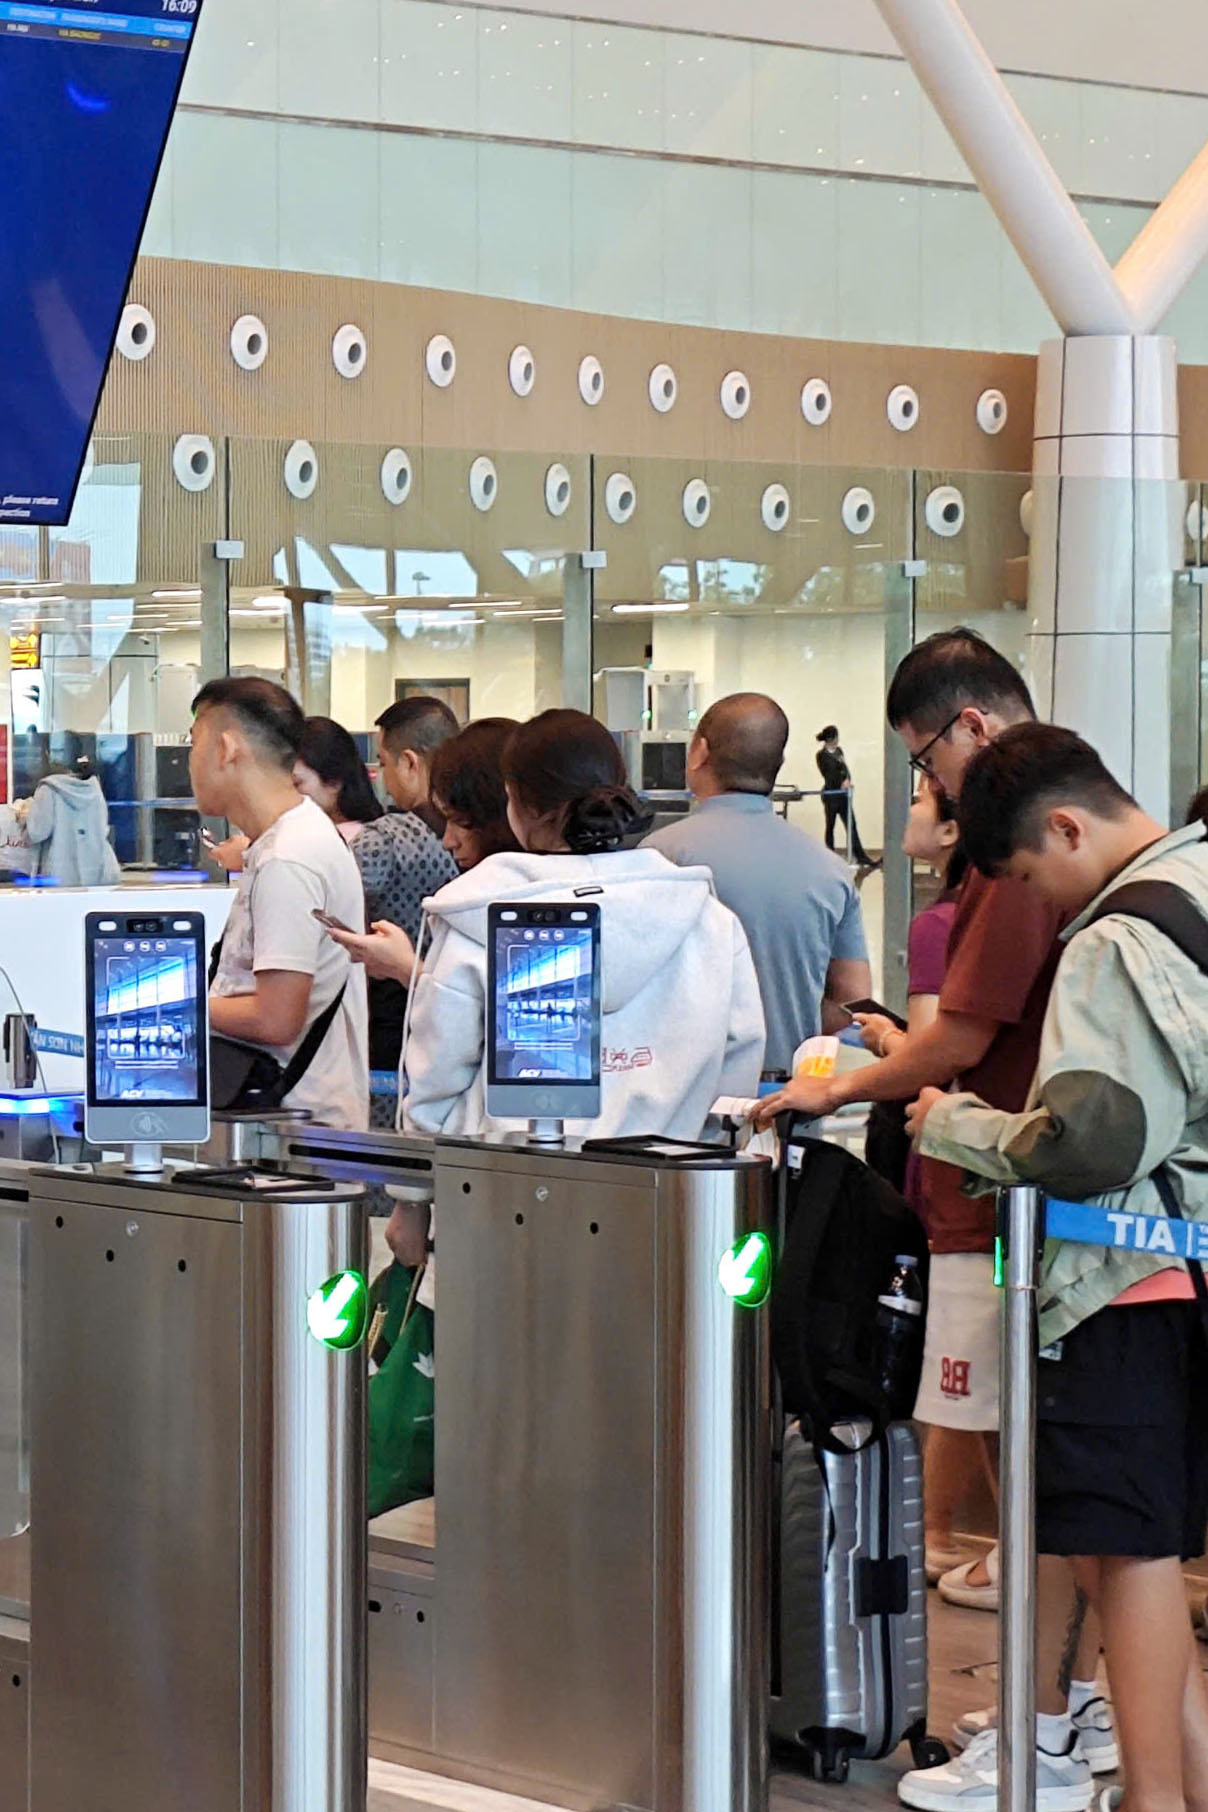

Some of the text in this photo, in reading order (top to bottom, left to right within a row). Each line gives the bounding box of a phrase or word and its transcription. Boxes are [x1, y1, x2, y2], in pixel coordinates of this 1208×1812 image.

[162, 0, 197, 13] 16:09
[2, 495, 31, 505] please
[32, 497, 58, 505] return
[1107, 1213, 1177, 1254] TIA
